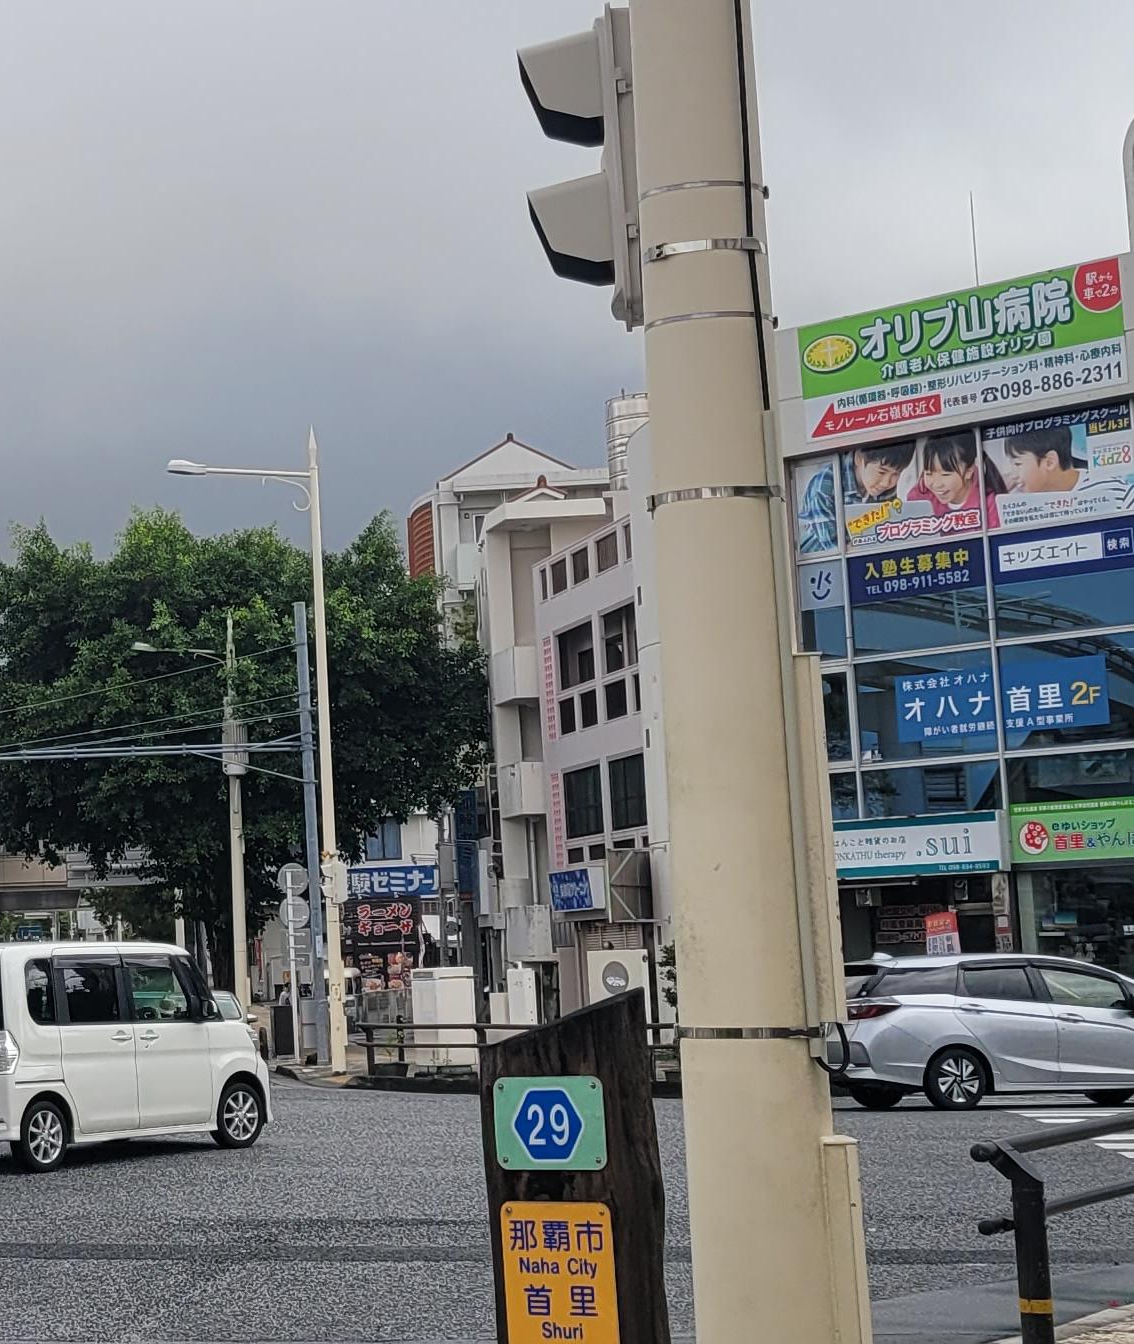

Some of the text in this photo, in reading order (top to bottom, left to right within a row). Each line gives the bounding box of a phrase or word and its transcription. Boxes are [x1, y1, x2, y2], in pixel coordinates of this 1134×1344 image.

[859, 277, 1071, 360] オリブ山病院
[881, 330, 1053, 380] 介護老人保健施設オリブ園
[943, 361, 1122, 408] 代表番号 098-886-2311
[825, 399, 937, 431] モノレール石嶺駅近く
[986, 405, 1129, 439] 子供向けプログラミングスクール
[877, 510, 981, 541] プログラミング教室
[1003, 541, 1088, 564] キッズエイト
[1107, 536, 1130, 551] 検索
[864, 548, 969, 580] 入塾生募集中
[866, 569, 970, 595] TEL 098-911-5582
[1070, 680, 1102, 706] 2F
[874, 850, 906, 861] therapy
[347, 869, 439, 894] 験ゼミナー
[357, 903, 413, 919] ラーメン
[527, 1103, 570, 1146] 29
[509, 1219, 604, 1253] 那覇市
[519, 1256, 598, 1279] Naha City
[524, 1284, 599, 1317] 首里
[542, 1322, 583, 1340] Shuri
